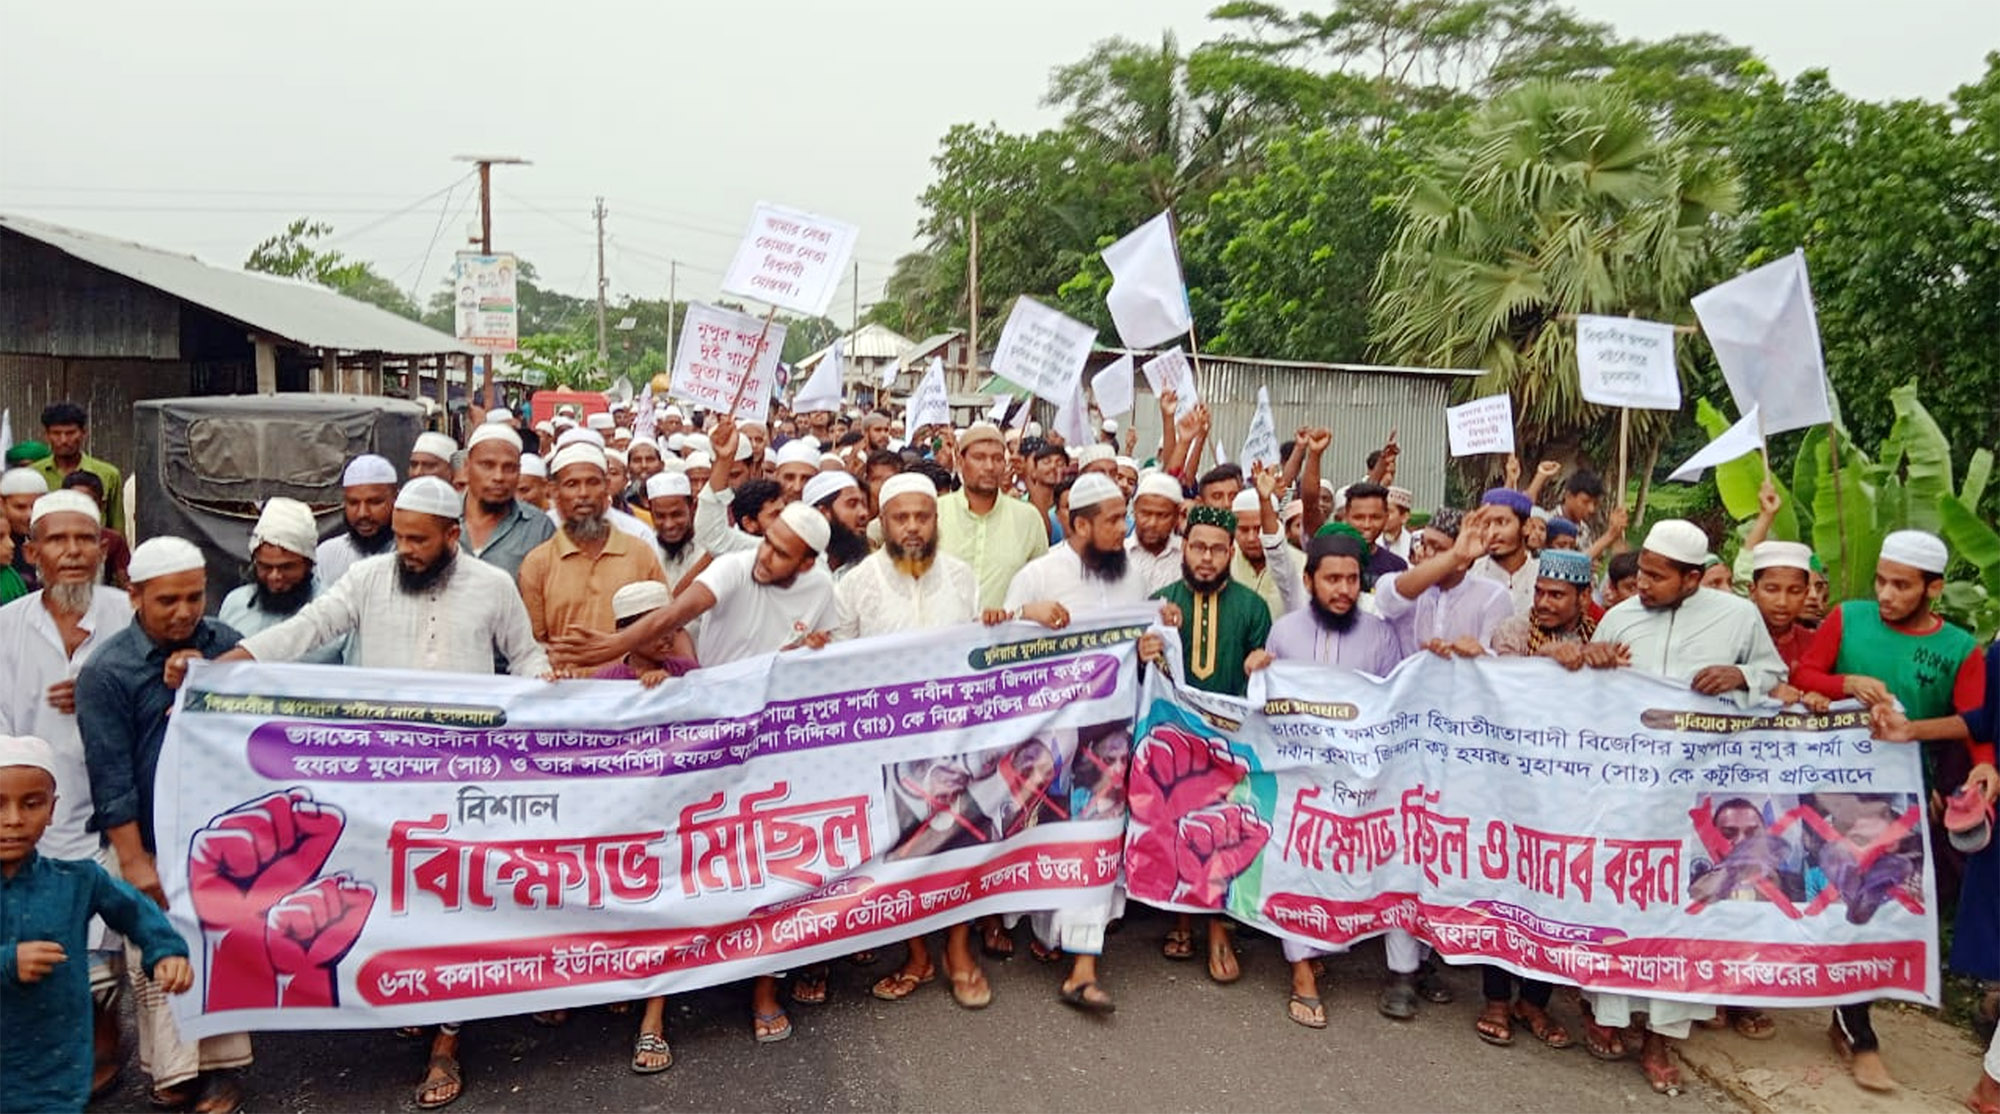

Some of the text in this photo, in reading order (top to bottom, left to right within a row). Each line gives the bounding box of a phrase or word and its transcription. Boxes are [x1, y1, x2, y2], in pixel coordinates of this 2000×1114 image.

[690, 363, 721, 382] জুতা
[725, 391, 757, 411] তলে
[285, 726, 372, 746] ভারতের
[376, 730, 478, 748] ক্ষমতাসীন
[486, 731, 528, 752] হিন্দু
[669, 718, 746, 742] বিজেপির
[845, 688, 878, 711] শর্মা
[885, 691, 900, 705] ও
[912, 680, 953, 702] নবীন
[958, 676, 997, 699] কুমার
[1000, 667, 1049, 690] জিন্দান
[1674, 714, 1728, 732] দুনিয়ার
[1833, 714, 1855, 727] এক
[292, 756, 360, 776] হযরত
[366, 755, 441, 780] মুহাম্মদ
[511, 759, 527, 772] ও
[534, 757, 575, 773] তার
[673, 747, 723, 769] হযরত
[785, 721, 847, 746] সিদ্দিকা
[902, 712, 926, 728] কে
[930, 706, 969, 726] নিয়ে
[1579, 727, 1672, 757] বিজেপির
[1807, 735, 1843, 758] শর্মা
[1852, 739, 1873, 754] ও
[1320, 746, 1370, 766] কুমার
[1454, 747, 1511, 764] হযরত
[1516, 756, 1593, 777] মুহাম্মদ
[1669, 768, 1694, 784] কে
[1702, 764, 1770, 788] কটুক্তির
[1777, 765, 1874, 785] প্রতিবাদে
[457, 786, 560, 826] বিশাল
[388, 781, 877, 917] বিক্ষোভ মিছিল
[1284, 788, 1395, 874] বিক্ষোভ
[1479, 821, 1510, 880] ও
[1514, 825, 1597, 903] মানব
[1605, 838, 1682, 912] বন্ধন
[377, 967, 430, 999] ৬নং
[435, 953, 544, 989] কলাকান্দা
[551, 944, 668, 981] ইউনিয়নের
[675, 936, 708, 963] নবী
[770, 907, 837, 944] প্রেমিক
[845, 890, 912, 930] তৌহিদী
[979, 864, 1031, 889] মতলব
[1036, 852, 1089, 887] উত্তর,
[1492, 901, 1594, 942] আয়োজনে
[1545, 941, 1611, 976] আলিম
[1620, 954, 1687, 983] মাদ্রাসা
[1697, 961, 1715, 978] ও
[1722, 953, 1818, 985] সর্বস্তরের
[1826, 958, 1895, 984] জনগণ
